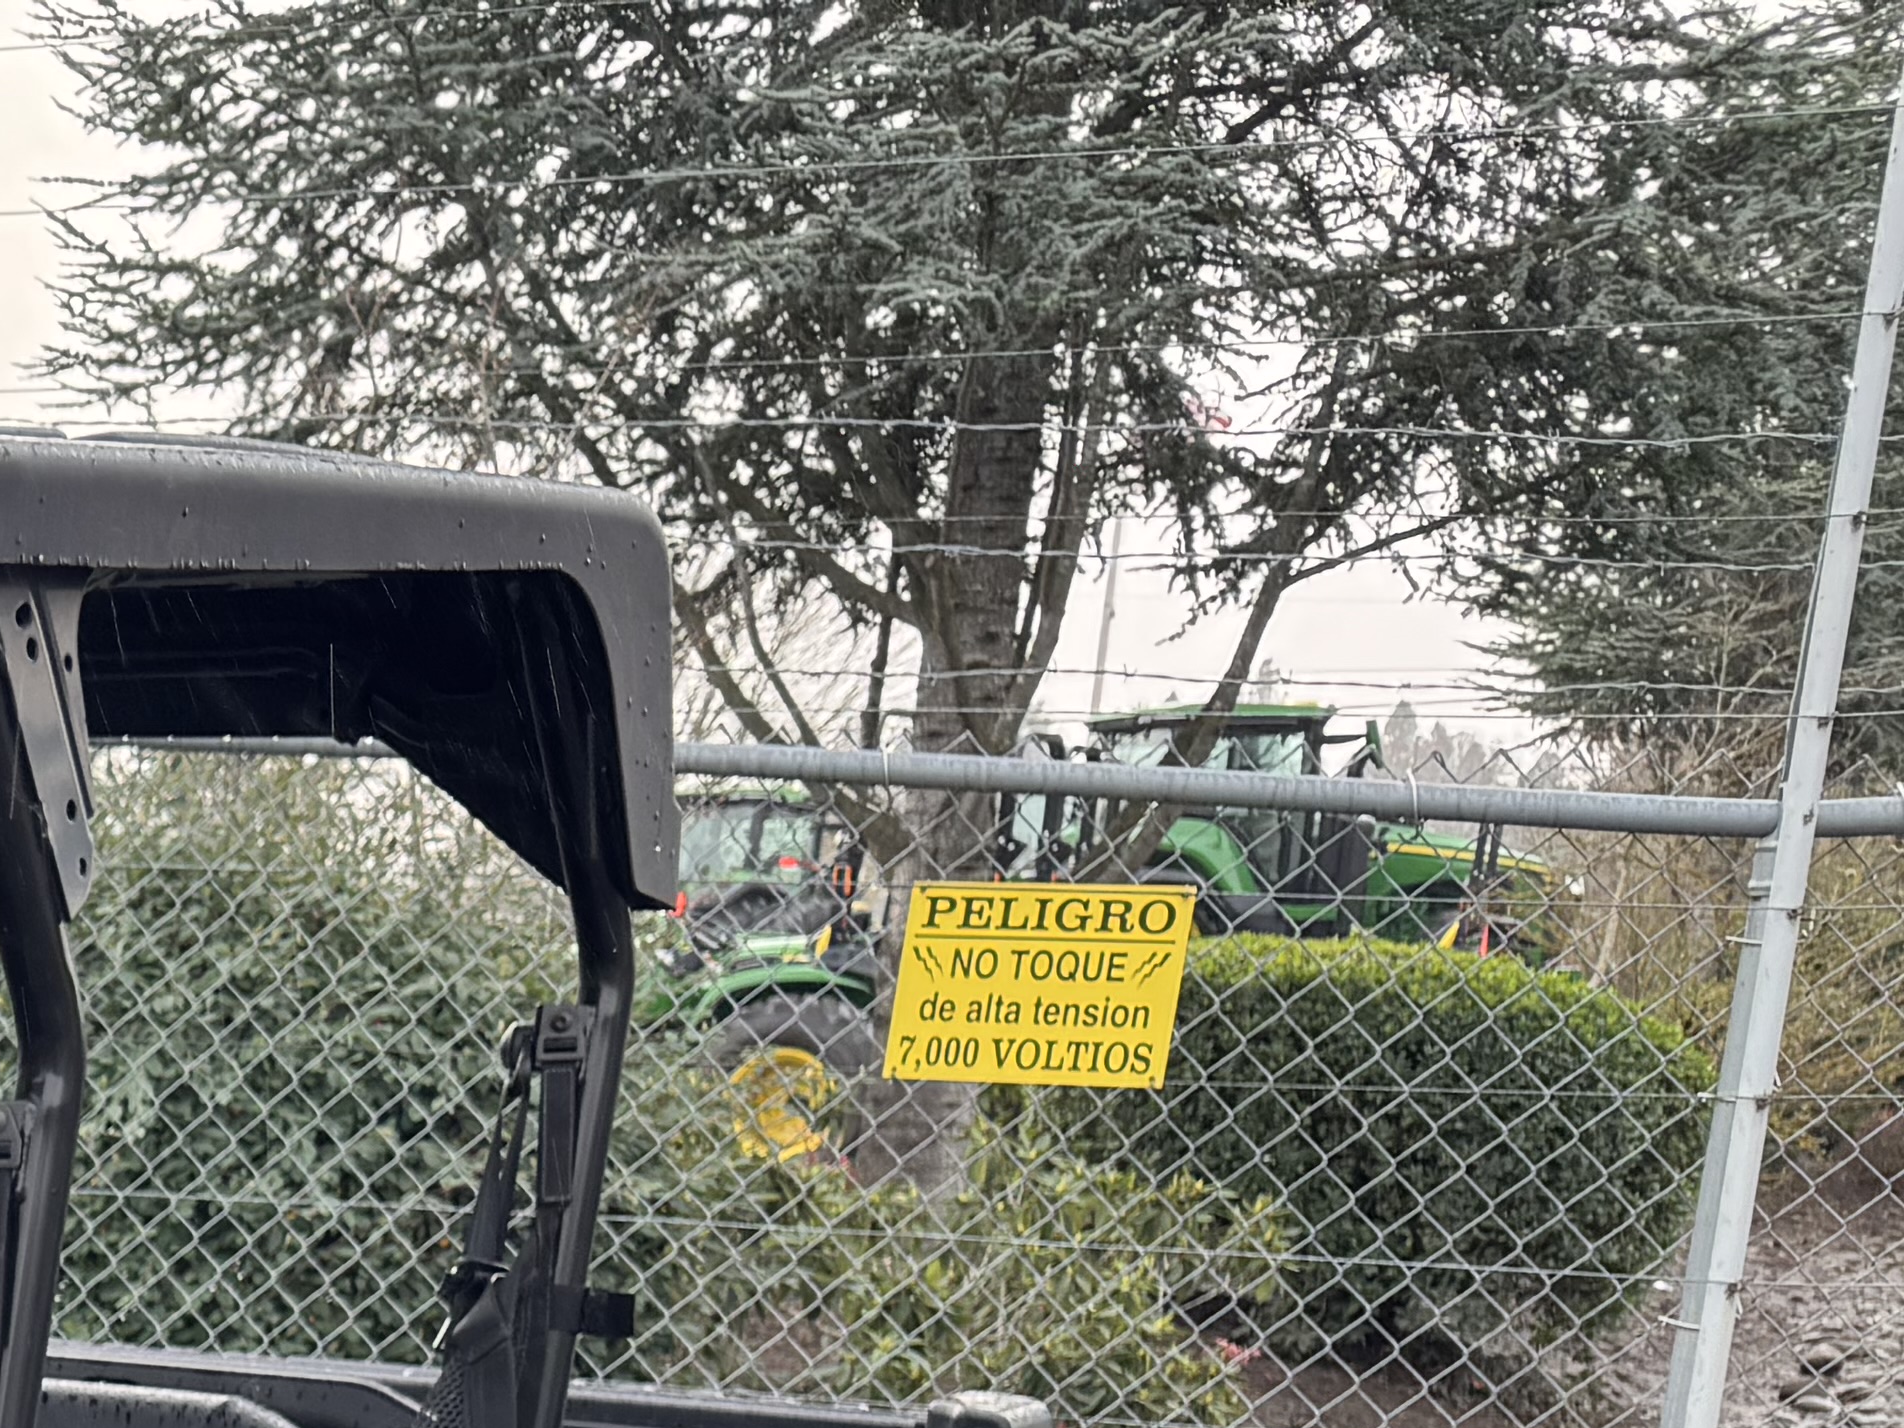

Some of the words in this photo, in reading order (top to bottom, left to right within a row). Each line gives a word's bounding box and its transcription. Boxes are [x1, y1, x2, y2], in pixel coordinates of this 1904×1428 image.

[921, 896, 1178, 935] PELIGRO
[950, 947, 999, 979] NO
[1010, 949, 1129, 982] TOQUE
[919, 991, 956, 1023] de
[965, 992, 1022, 1024] alta
[1033, 995, 1151, 1029] tension
[899, 1035, 980, 1073] 7,000
[991, 1037, 1154, 1076] VOLTIOS
